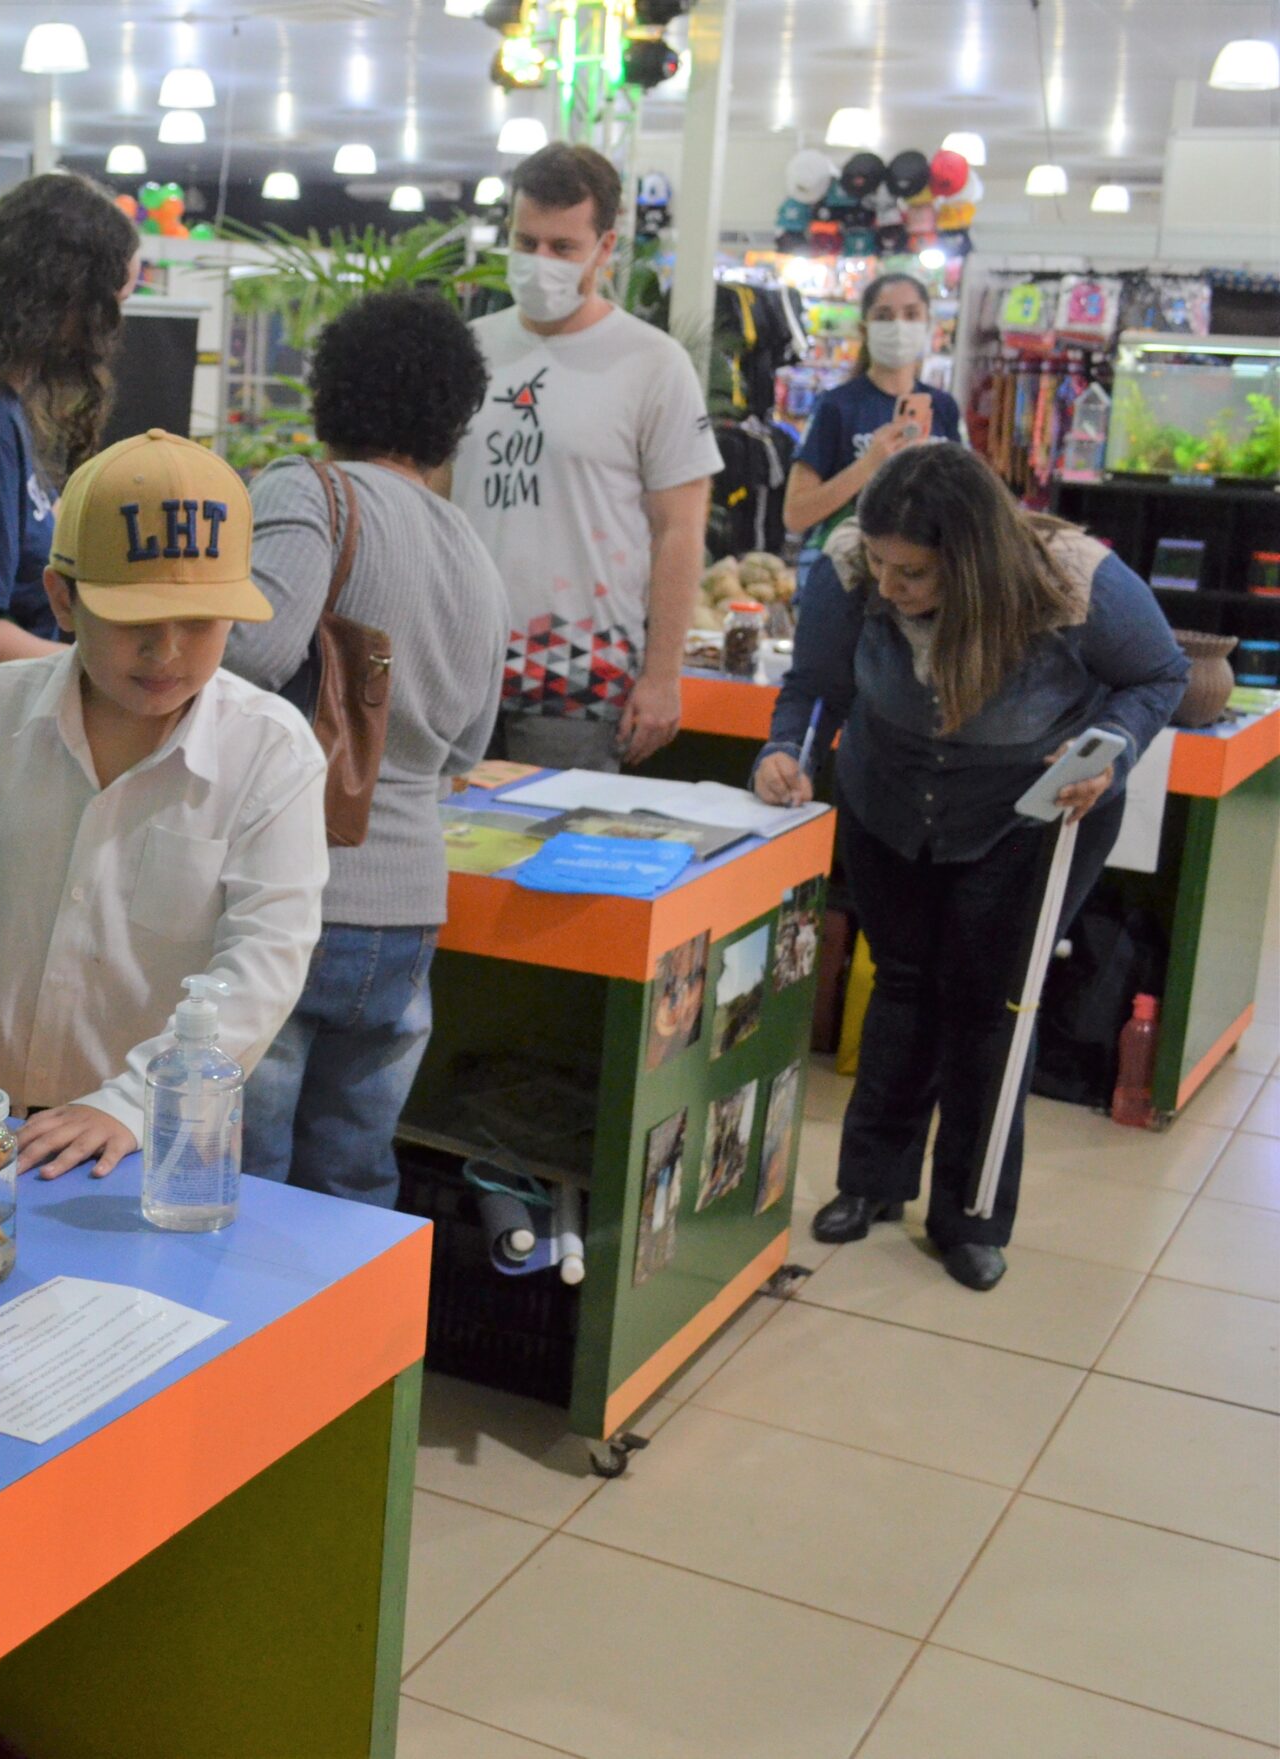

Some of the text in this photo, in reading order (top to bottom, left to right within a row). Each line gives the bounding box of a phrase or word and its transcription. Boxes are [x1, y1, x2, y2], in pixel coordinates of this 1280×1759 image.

[486, 429, 544, 467] SOU
[484, 468, 540, 510] UEM
[120, 499, 227, 562] LHT
